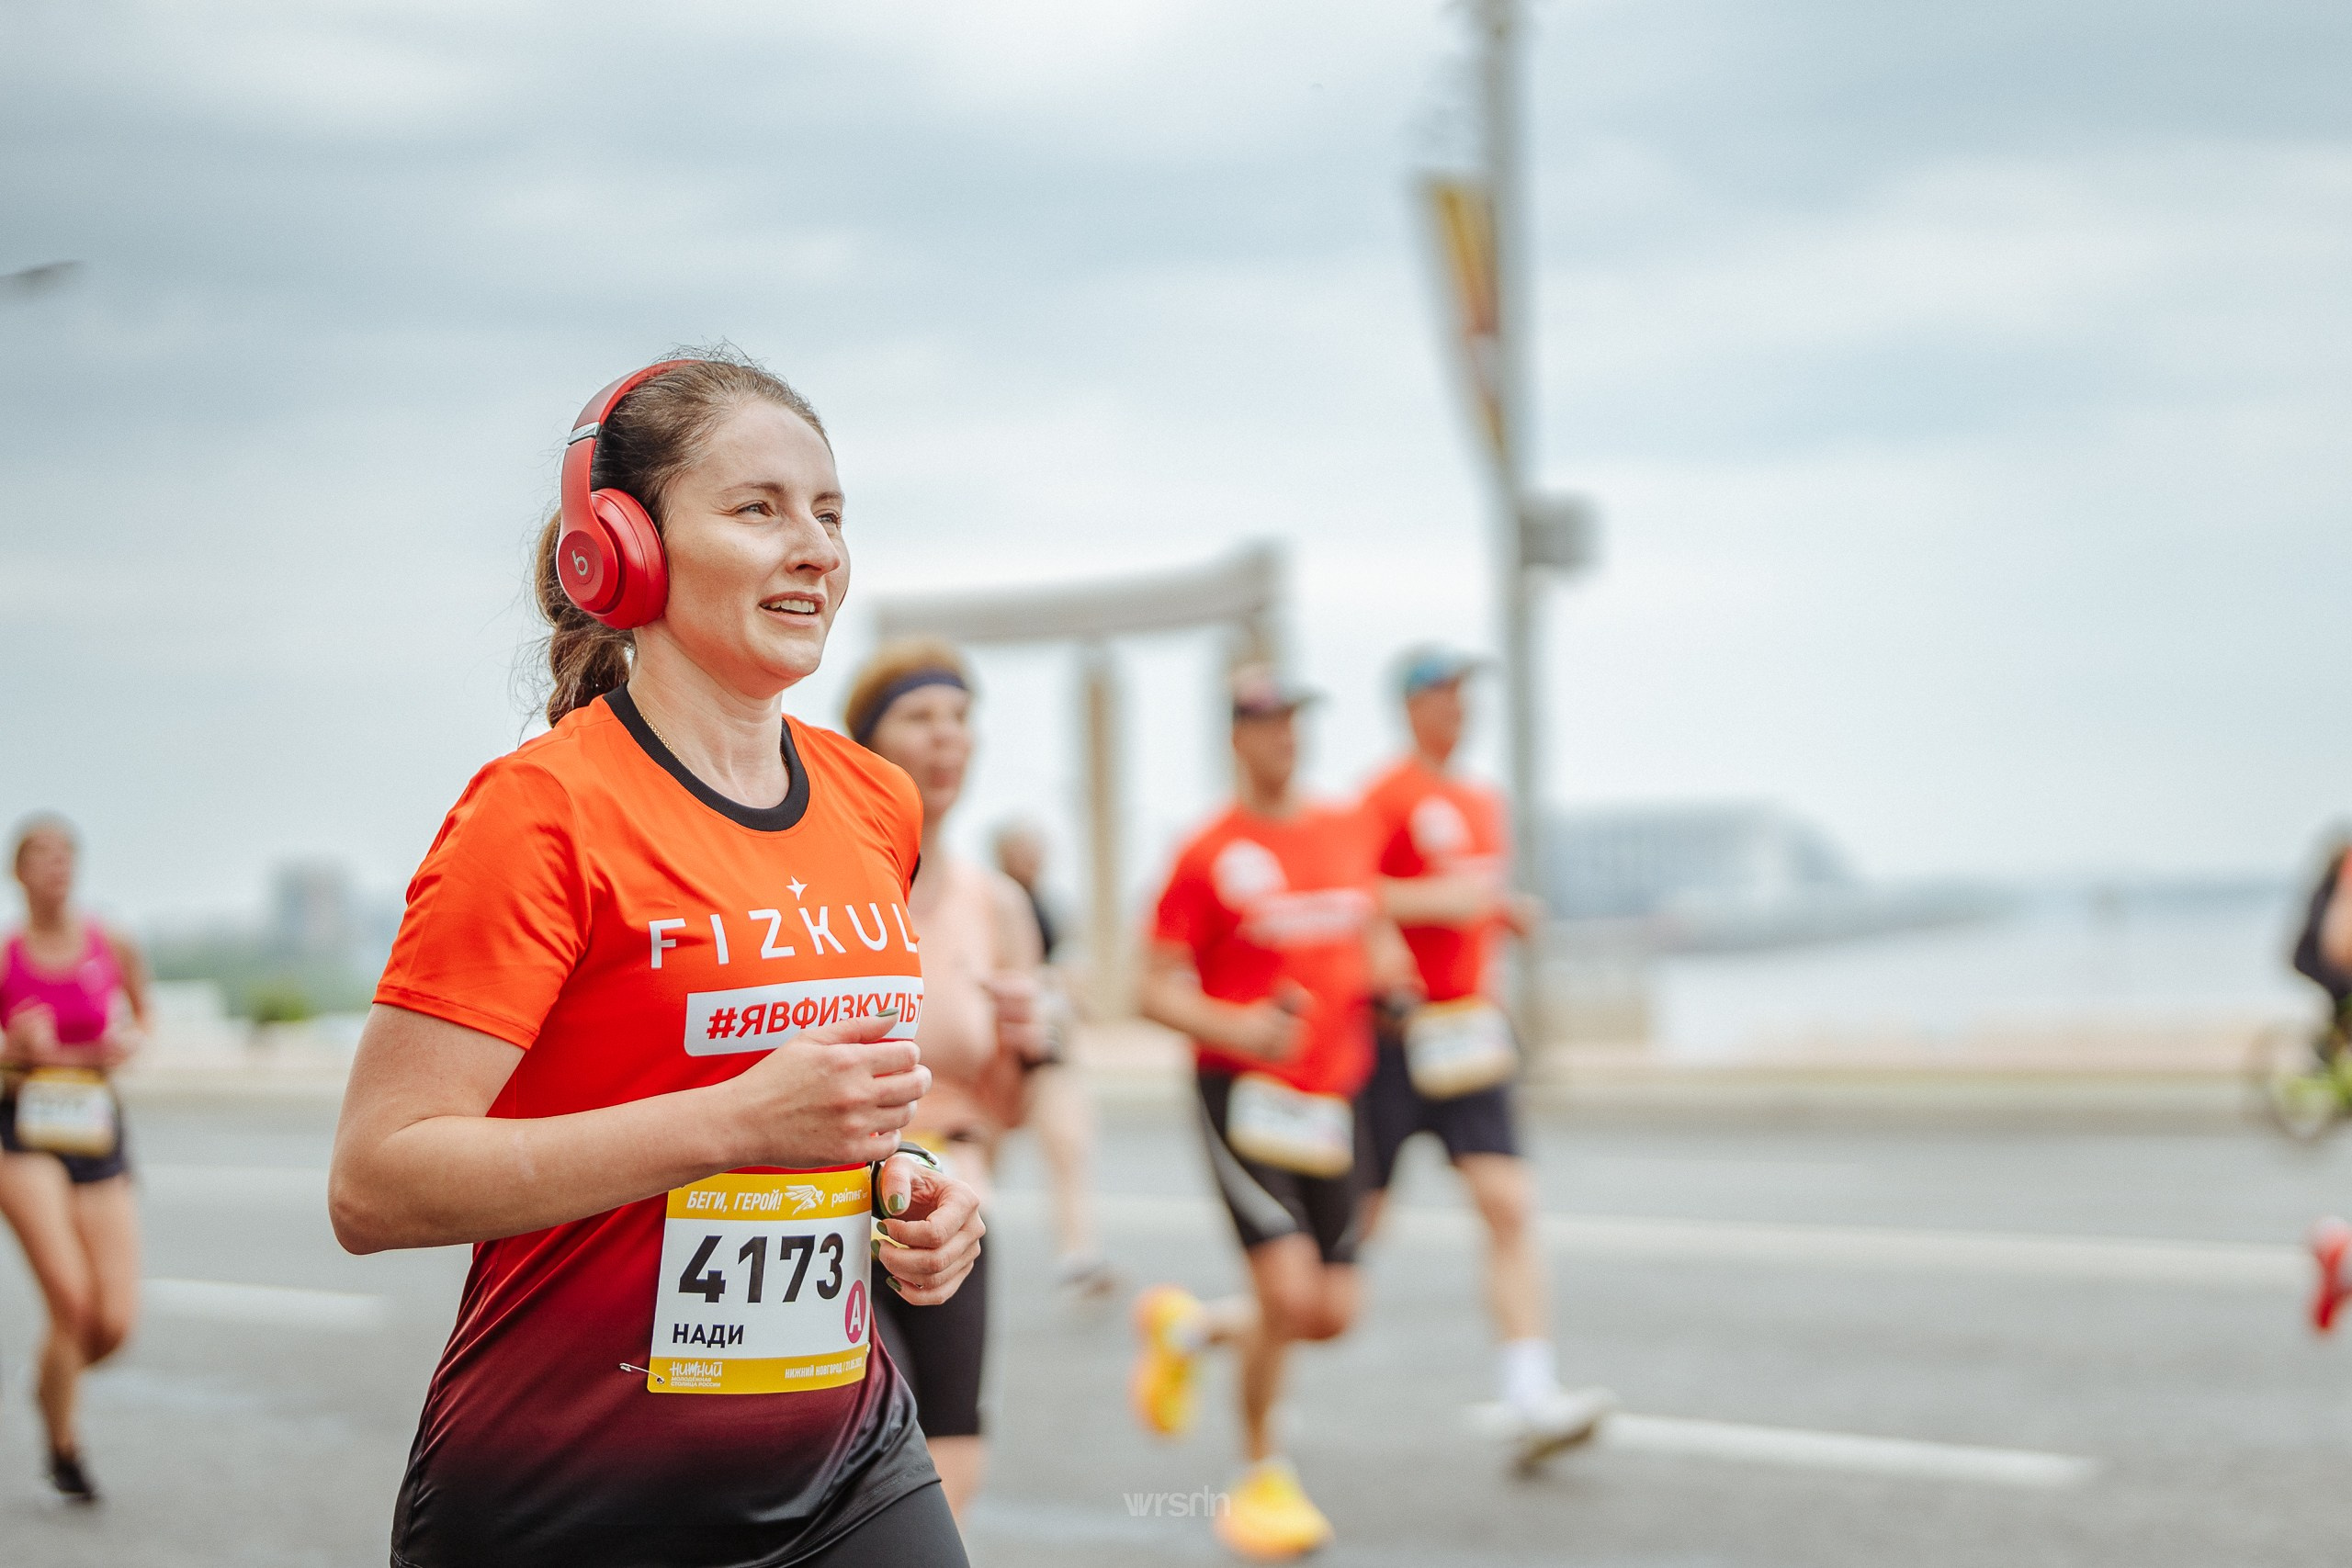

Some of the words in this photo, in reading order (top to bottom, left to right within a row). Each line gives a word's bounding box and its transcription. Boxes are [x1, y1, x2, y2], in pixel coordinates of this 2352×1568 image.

[648, 902, 918, 969] FIZKUL
[686, 1190, 728, 1213] БЕГИ,
[733, 1189, 783, 1211] ГЕРОЙ!
[678, 1232, 844, 1303] 4173
[672, 1323, 745, 1348] НАДИ
[785, 1365, 814, 1378] НИЖНИЙ
